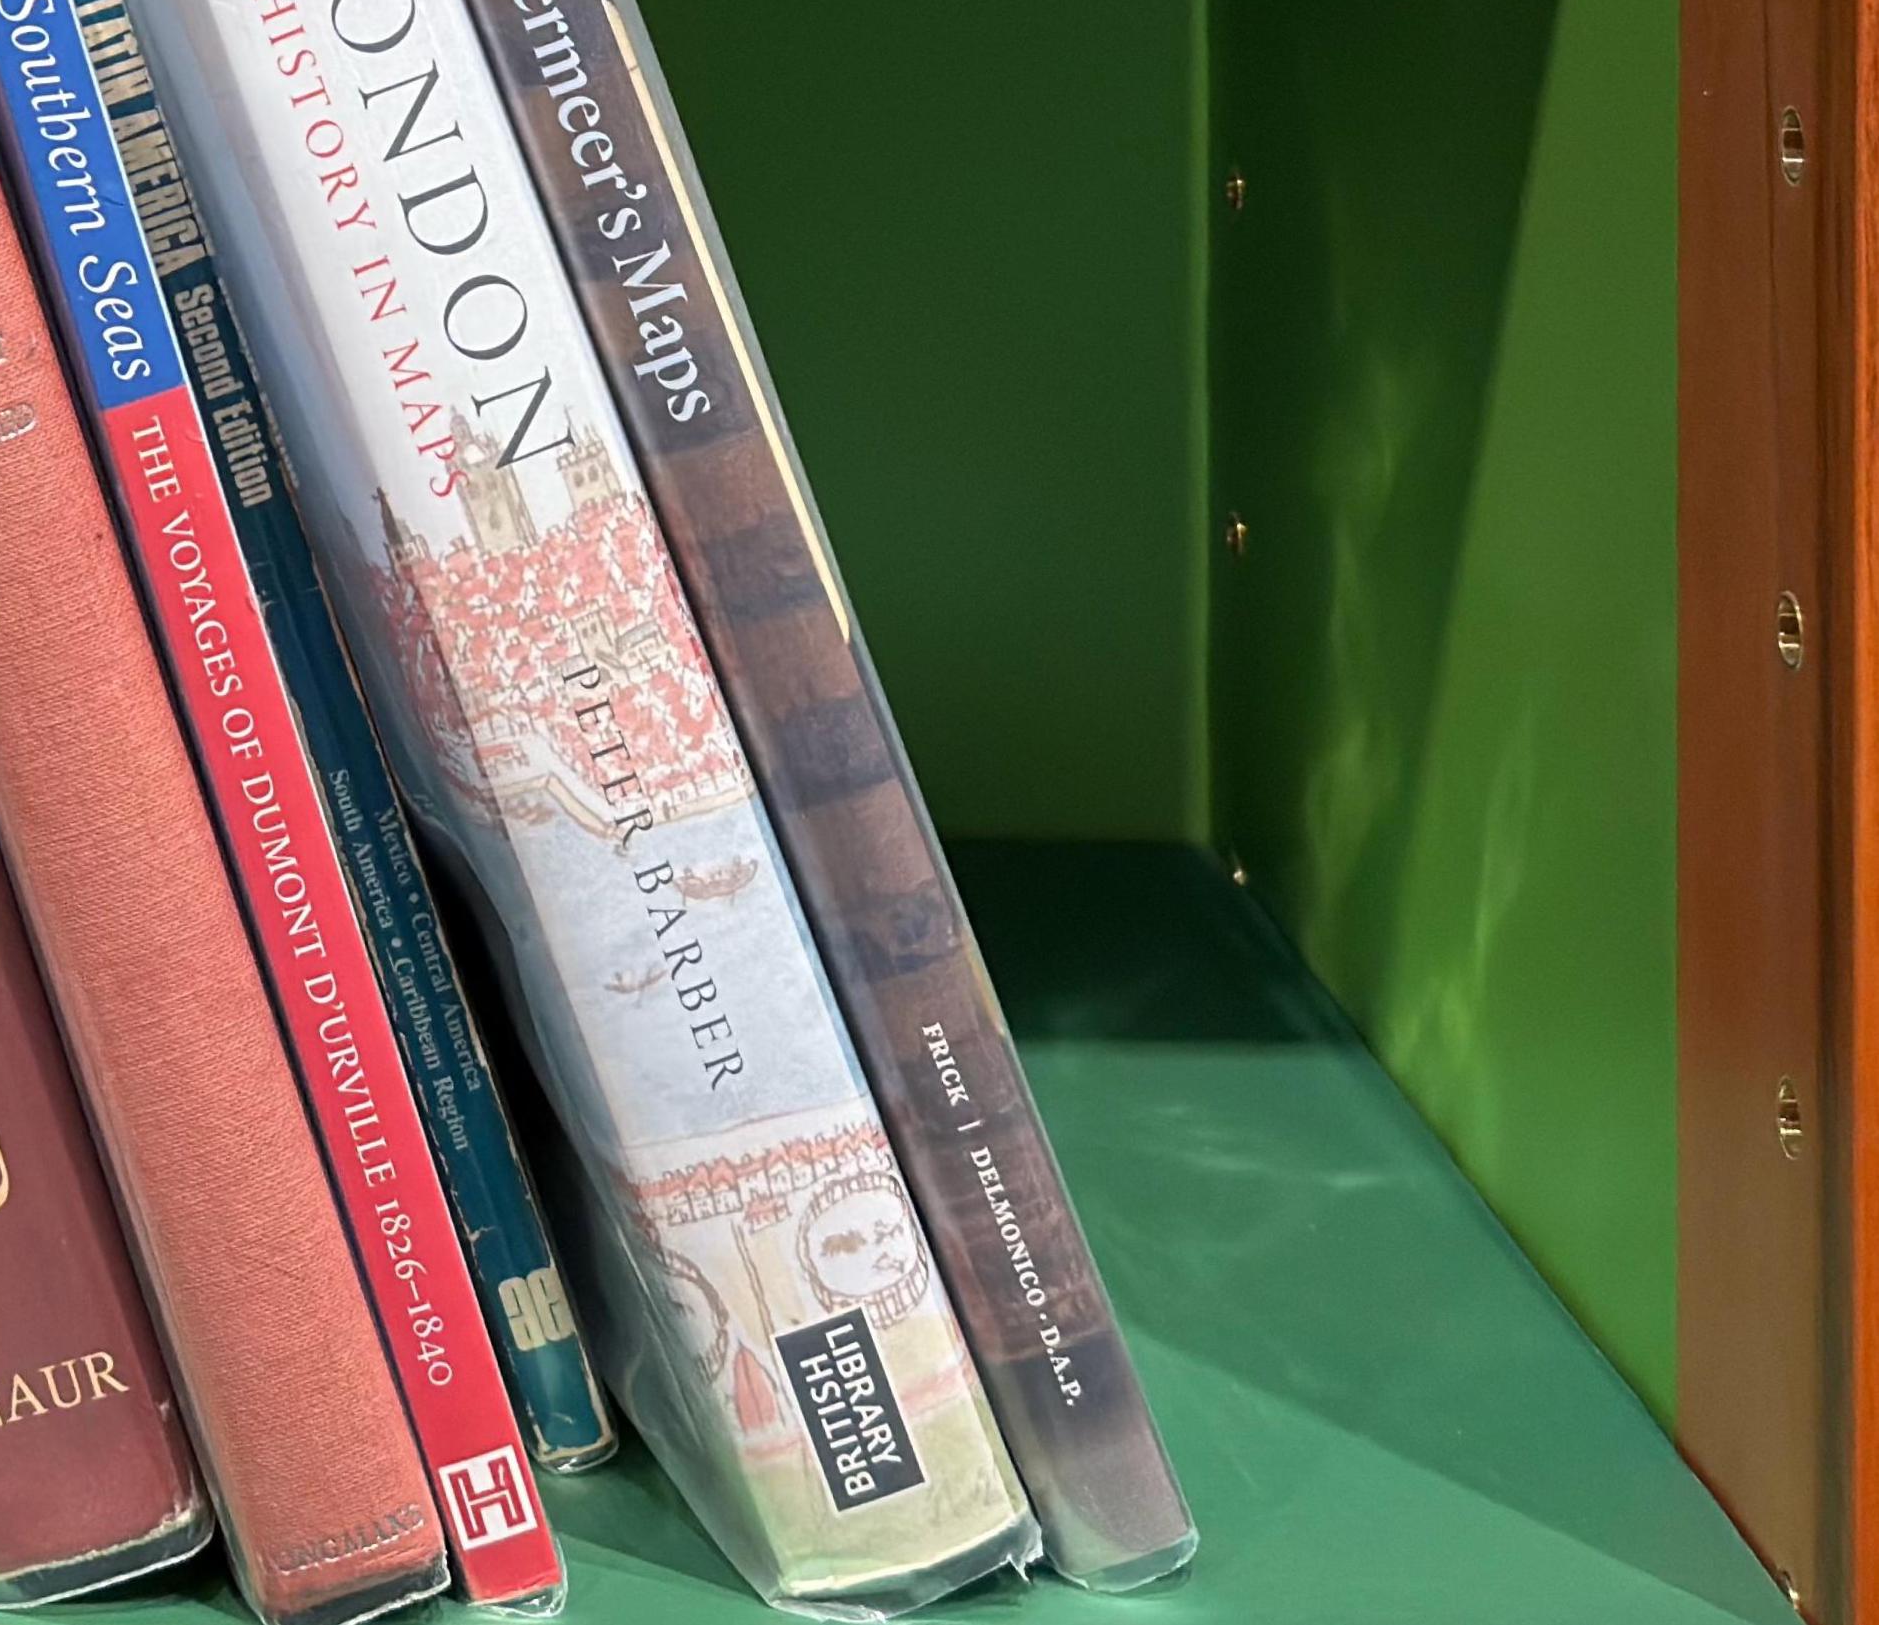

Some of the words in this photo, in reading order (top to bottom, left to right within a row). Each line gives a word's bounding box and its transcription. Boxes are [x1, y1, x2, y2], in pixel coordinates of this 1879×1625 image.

[78, 254, 151, 382] Seas
[114, 107, 211, 275] AMERICA
[174, 284, 244, 400] Second
[213, 398, 273, 508] Edition
[353, 255, 406, 321] IN
[383, 338, 470, 499] MAPS
[612, 242, 711, 423] Maps
[131, 415, 181, 503] THE
[160, 510, 244, 697] VOYAGES
[223, 707, 264, 759] OF
[242, 771, 325, 959] DUMONT
[377, 805, 411, 885] Mexico
[412, 911, 444, 993] Central
[442, 1002, 482, 1093] America
[561, 664, 654, 850] PETER
[633, 862, 744, 1090] BARBER
[330, 768, 364, 832] South
[353, 841, 394, 930] America
[395, 956, 440, 1071] Caribbean
[433, 1076, 470, 1151] Region
[304, 971, 397, 1188] D'URVILLE
[922, 1022, 969, 1106] FRICK
[969, 1146, 1047, 1309] DELMONICO
[1039, 1325, 1082, 1407] D.A.P.
[799, 1353, 875, 1496] BRITISH
[826, 1322, 902, 1467] LIBRARY
